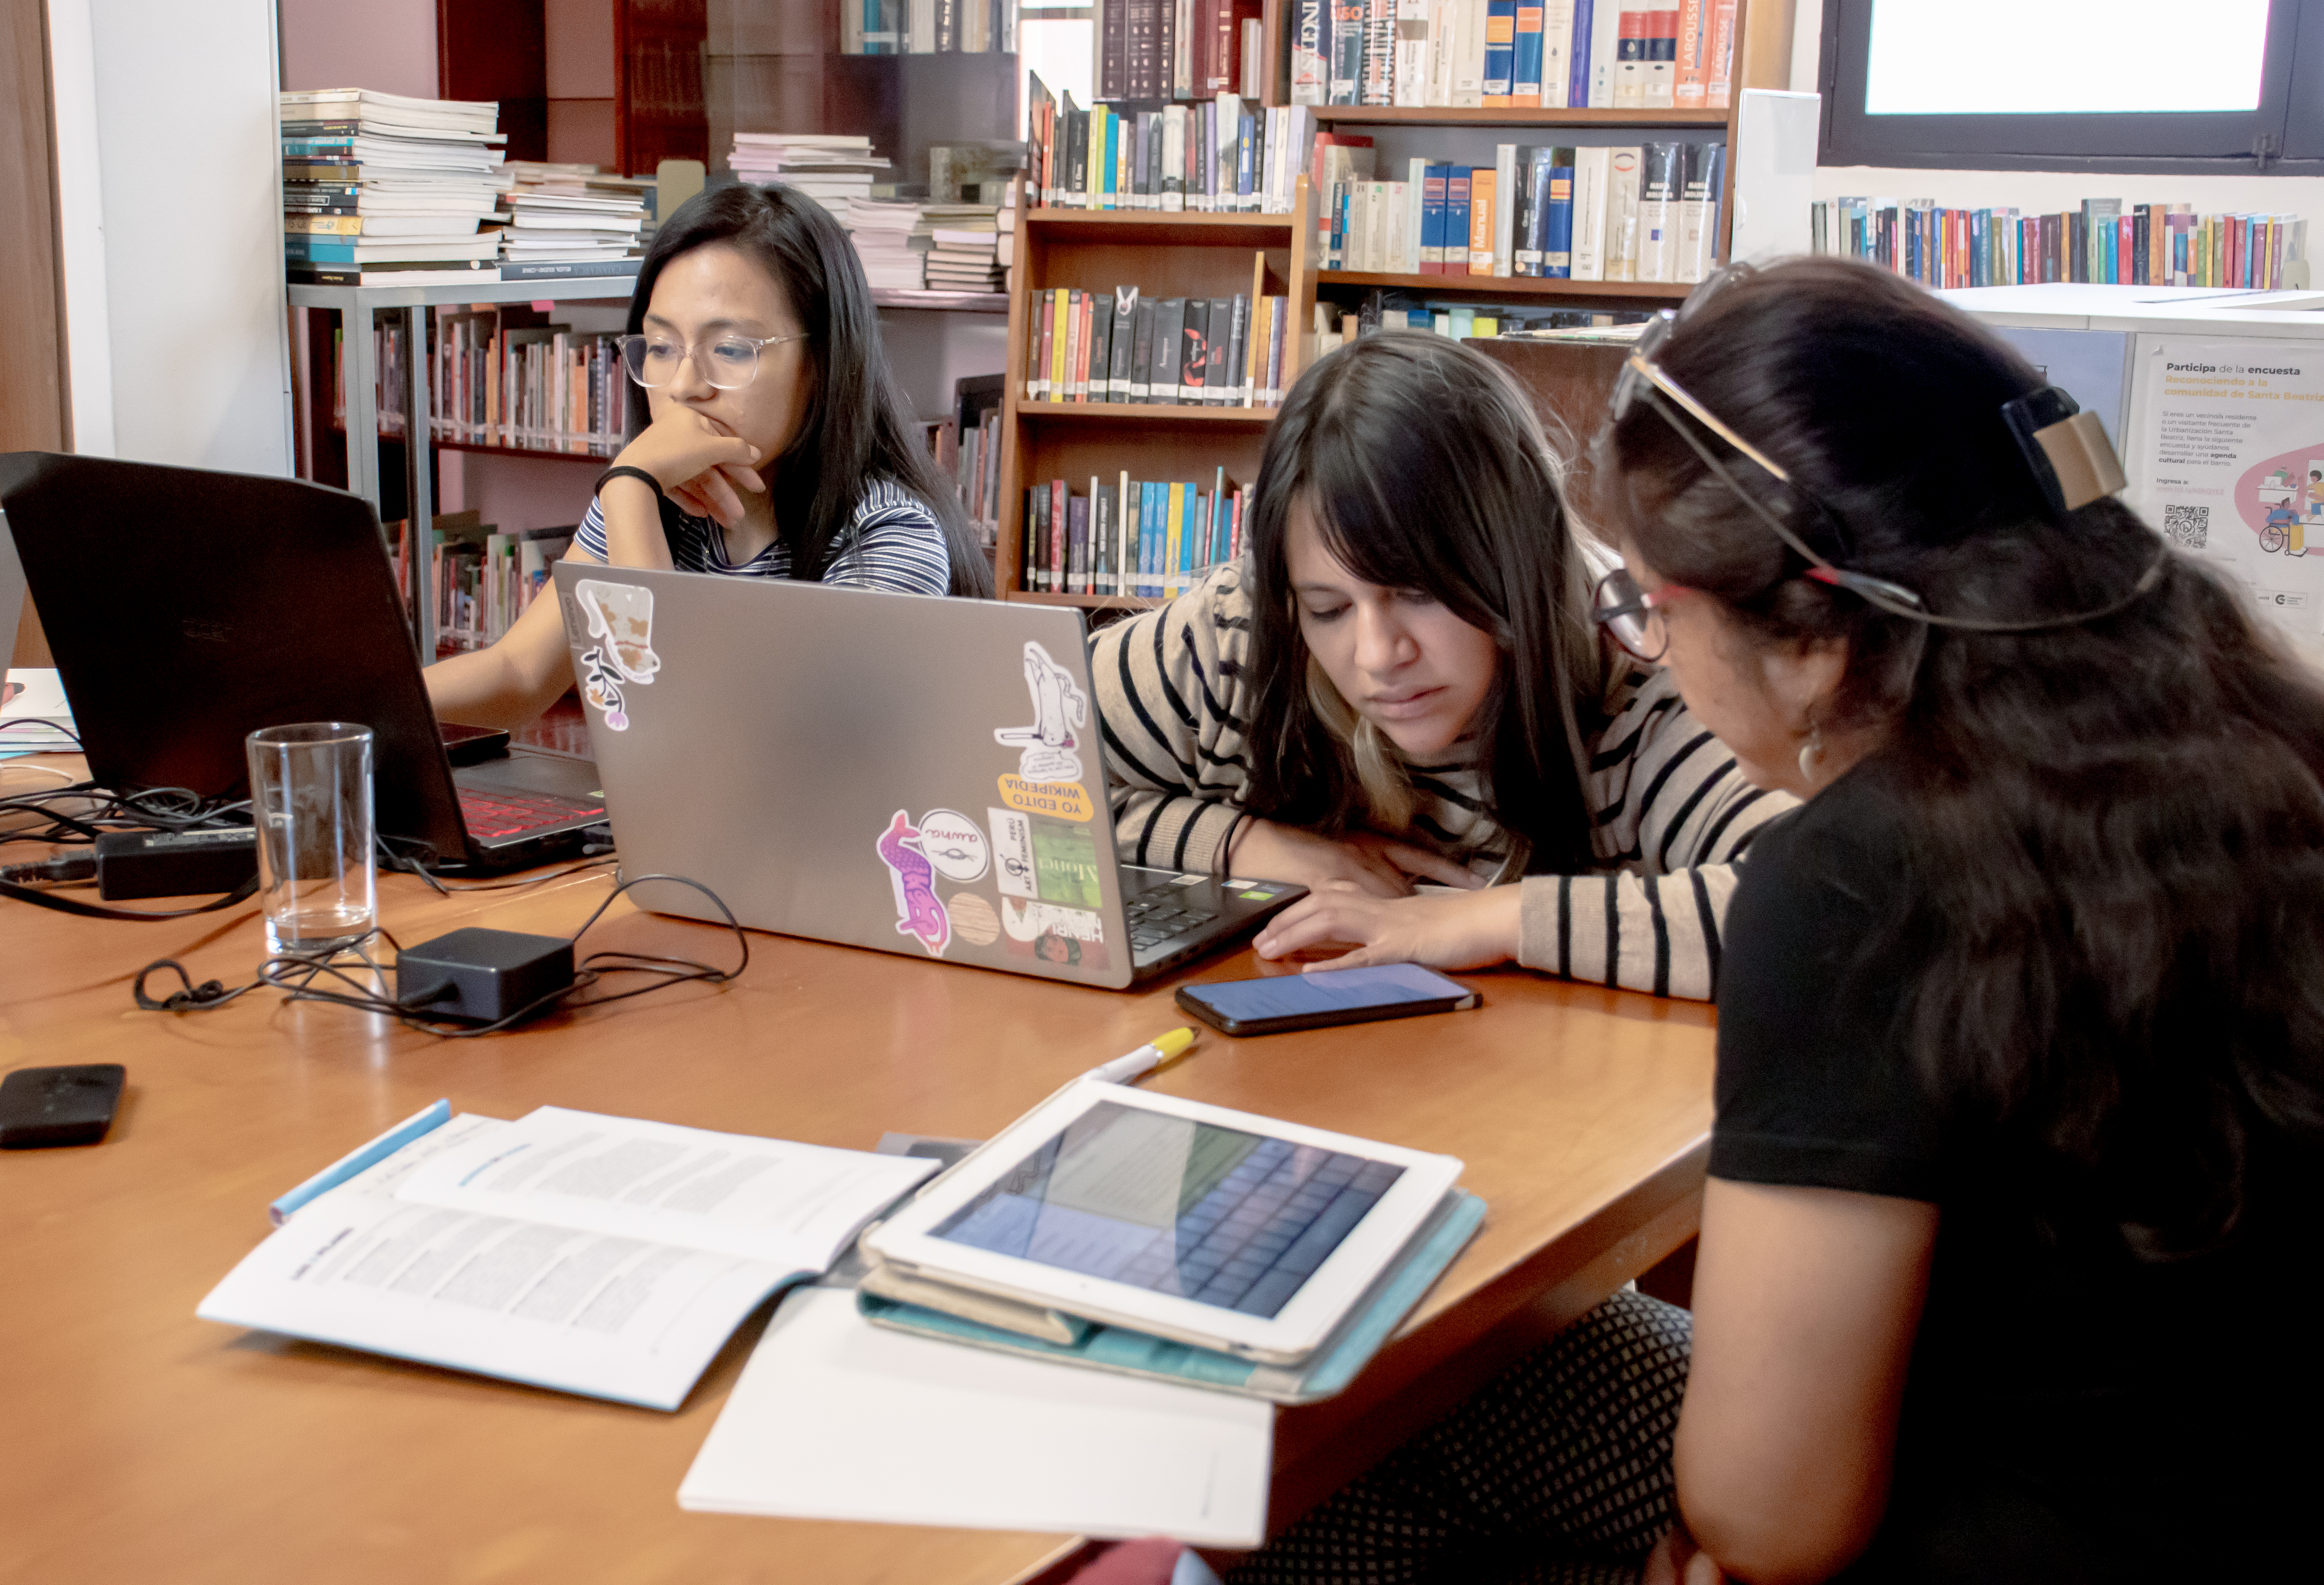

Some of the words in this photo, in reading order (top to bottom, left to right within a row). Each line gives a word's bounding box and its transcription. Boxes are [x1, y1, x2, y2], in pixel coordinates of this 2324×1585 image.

[1715, 18, 1728, 77] LAROUSSE
[1473, 199, 1487, 248] Manual
[2167, 363, 2216, 373] Participa
[2219, 364, 2232, 373] de
[2236, 365, 2244, 373] la
[2248, 367, 2301, 375] encuesta
[2165, 375, 2245, 385] Reconociendo
[2258, 378, 2268, 387] la
[2164, 388, 2227, 397] comunidad
[2230, 390, 2245, 398] de
[2248, 391, 2280, 400] Santa
[2284, 392, 2324, 402] Beatriz
[1005, 778, 1080, 799] WIKIPEDIA
[1013, 794, 1057, 810] EDITO
[1062, 802, 1081, 815] YO
[1018, 819, 1028, 862] FEMINISM
[1023, 876, 1032, 891] ART
[1052, 923, 1103, 944] HENRI
